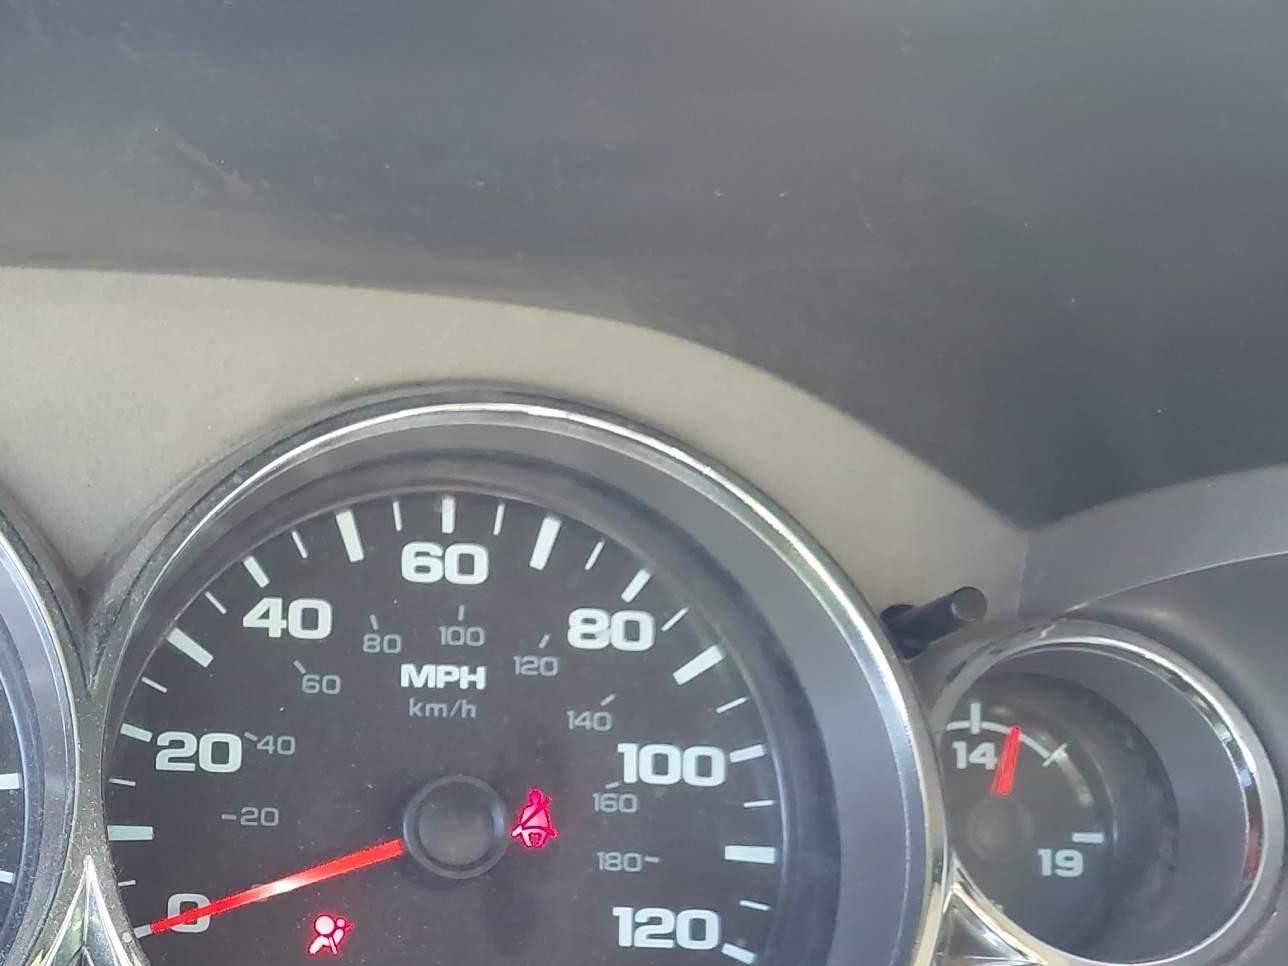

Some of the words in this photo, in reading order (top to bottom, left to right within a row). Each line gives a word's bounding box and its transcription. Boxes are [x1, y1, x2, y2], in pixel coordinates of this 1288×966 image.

[400, 543, 490, 585] 60
[242, 597, 332, 640] 40
[567, 608, 655, 652] 80
[362, 633, 403, 655] 80
[439, 625, 486, 647] 100
[400, 664, 487, 690] MPH
[513, 655, 559, 678] 120
[302, 674, 341, 695] 60
[408, 697, 478, 719] km/h
[567, 711, 612, 732] 140
[155, 732, 243, 772] 20
[256, 734, 296, 756] 40
[952, 741, 998, 770] 14
[618, 742, 727, 787] 100
[592, 792, 638, 814] 160
[240, 807, 280, 828] 20
[597, 851, 642, 873] 180
[1037, 849, 1084, 877] 19
[167, 894, 212, 934] 0
[612, 907, 720, 951] 120
